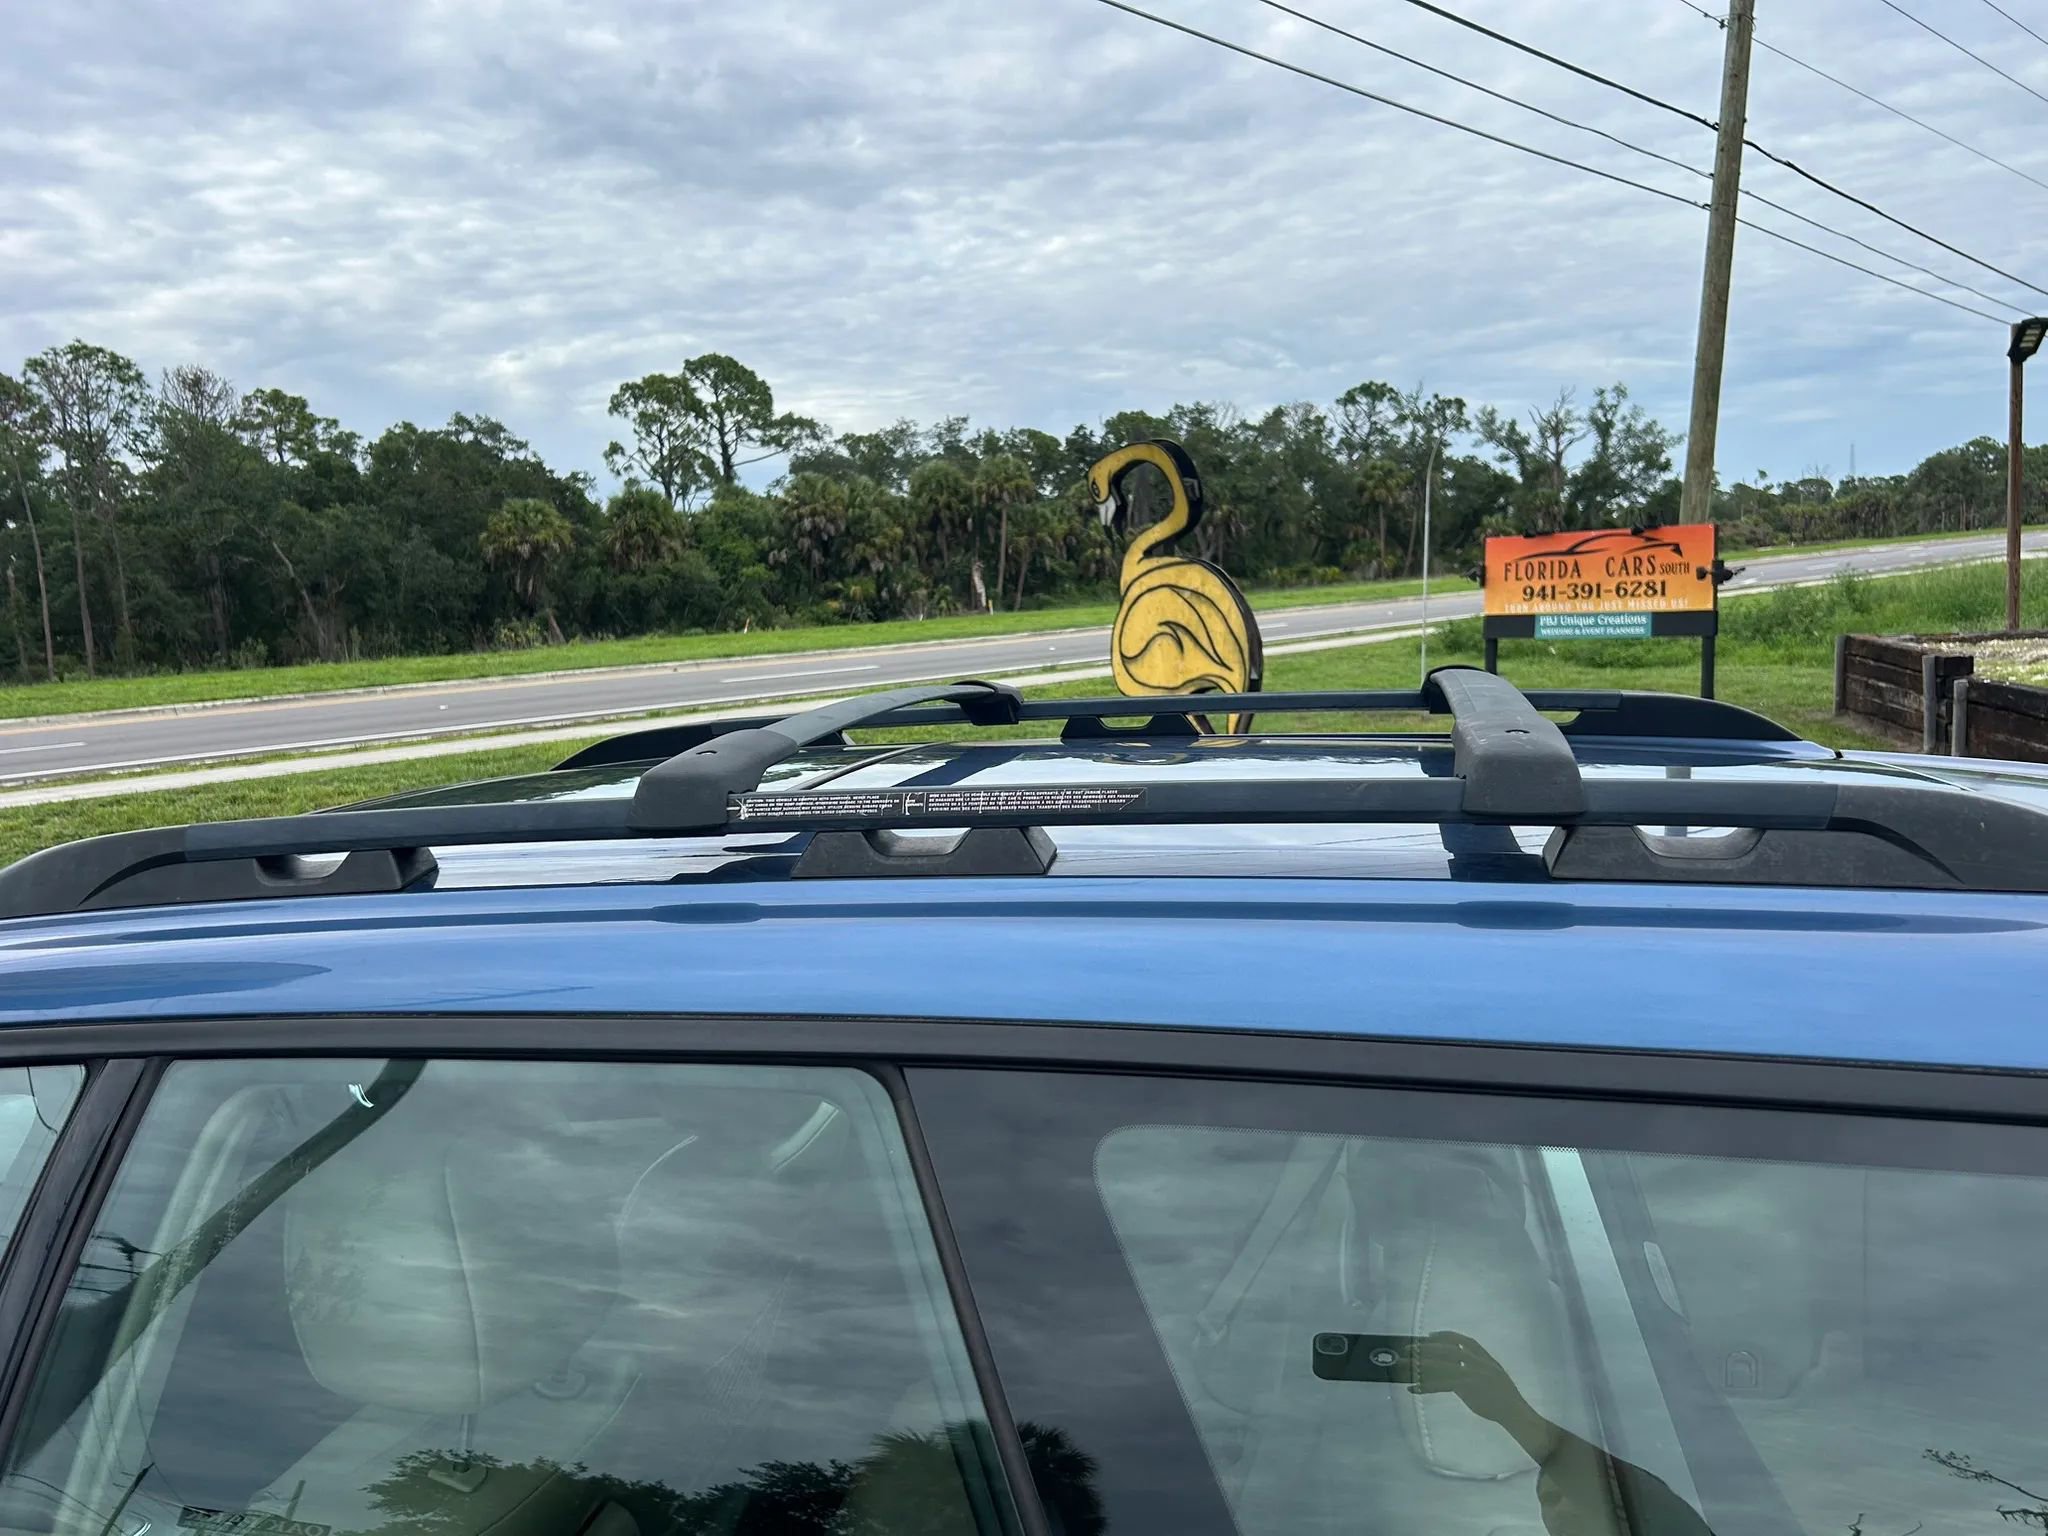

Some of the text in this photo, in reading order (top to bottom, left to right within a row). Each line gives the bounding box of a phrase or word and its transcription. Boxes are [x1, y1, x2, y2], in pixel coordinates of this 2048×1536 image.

[1504, 554, 1690, 582] FLORIDA CARS SOUTH
[1522, 579, 1666, 602] 941-391-6281
[1600, 599, 1623, 611] JUST
[1627, 598, 1667, 610] MISSED
[1539, 614, 1648, 628] PBJ Unique Creations
